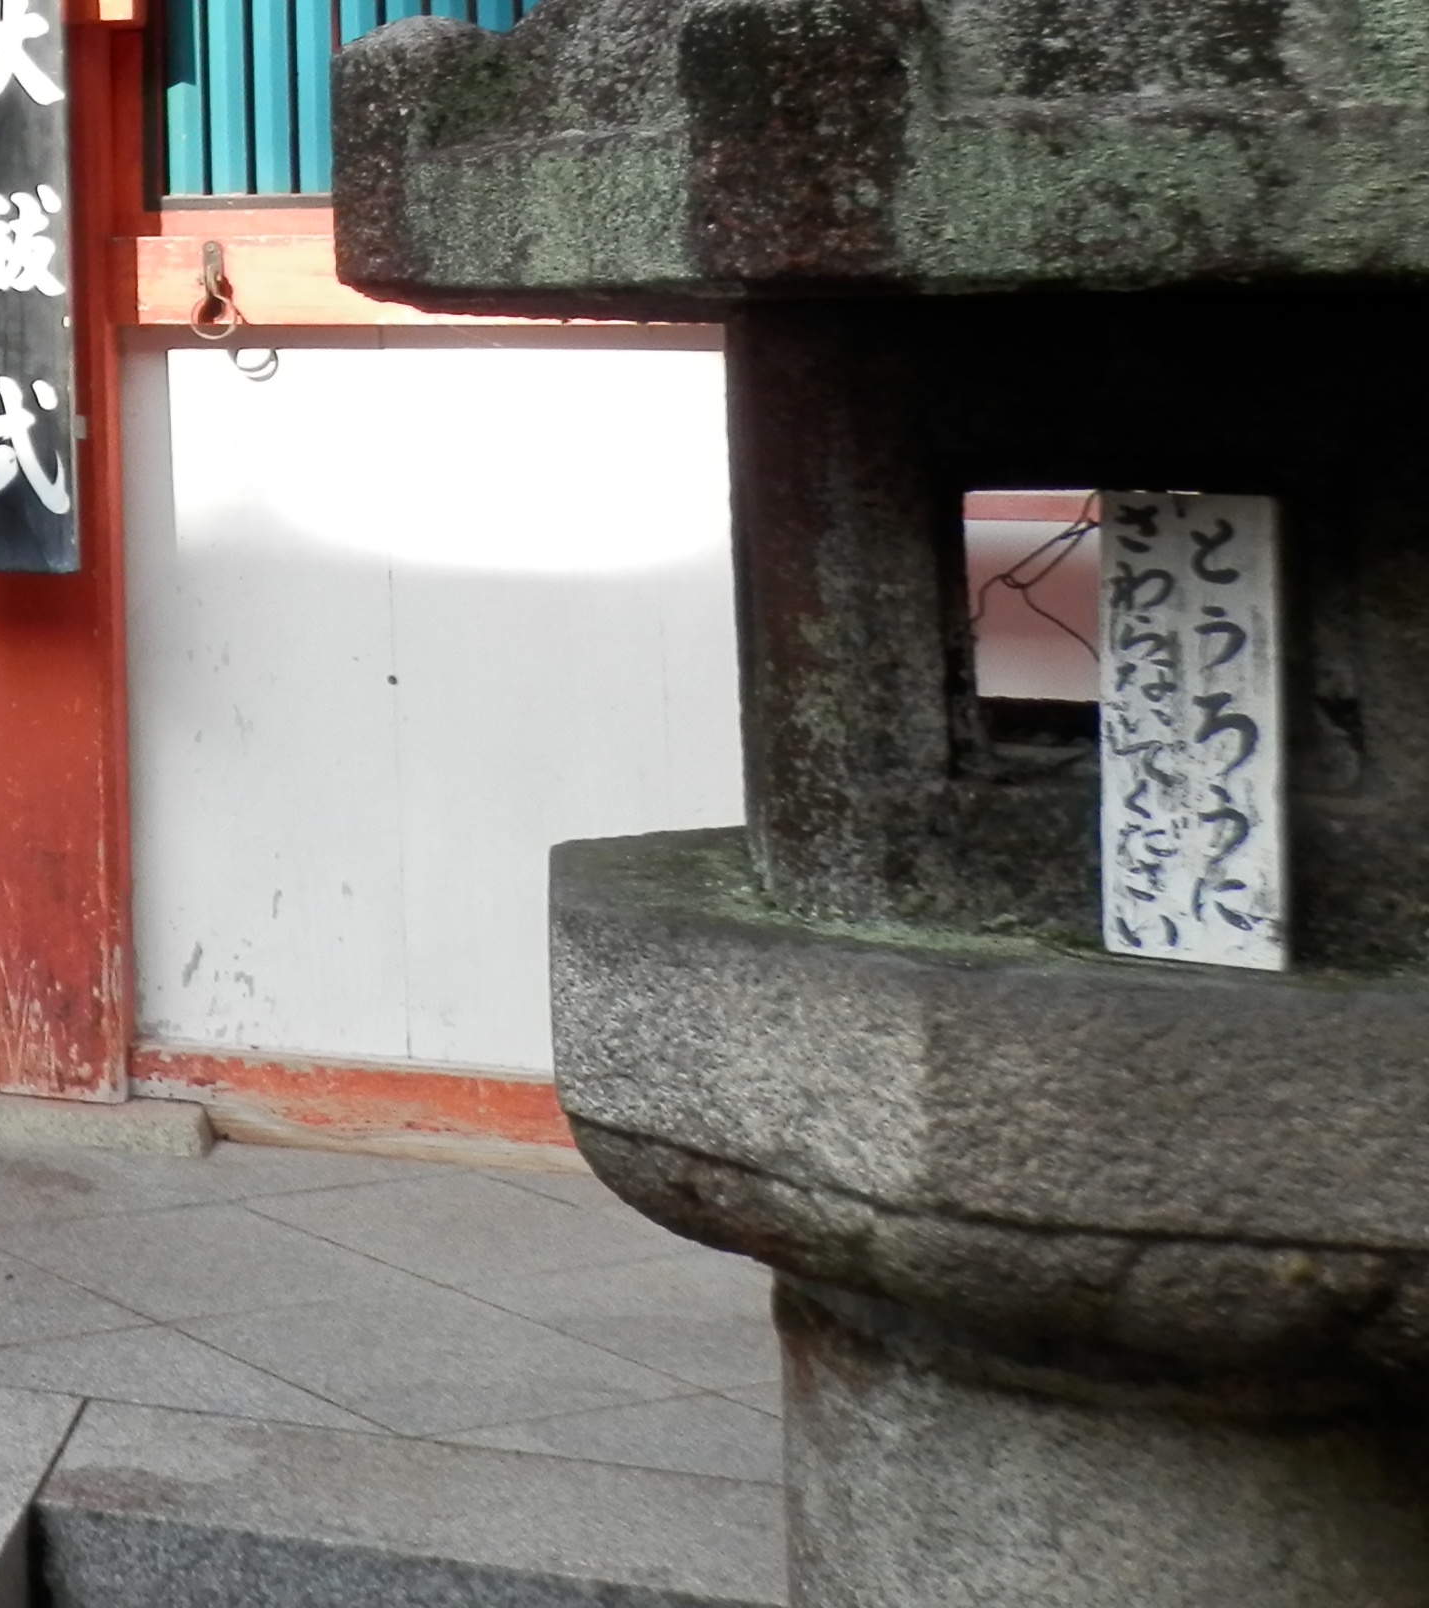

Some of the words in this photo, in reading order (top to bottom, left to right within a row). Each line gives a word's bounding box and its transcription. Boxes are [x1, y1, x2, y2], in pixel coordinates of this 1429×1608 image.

[1107, 503, 1187, 949] さわらないでください
[1190, 518, 1261, 932] とうろうに
